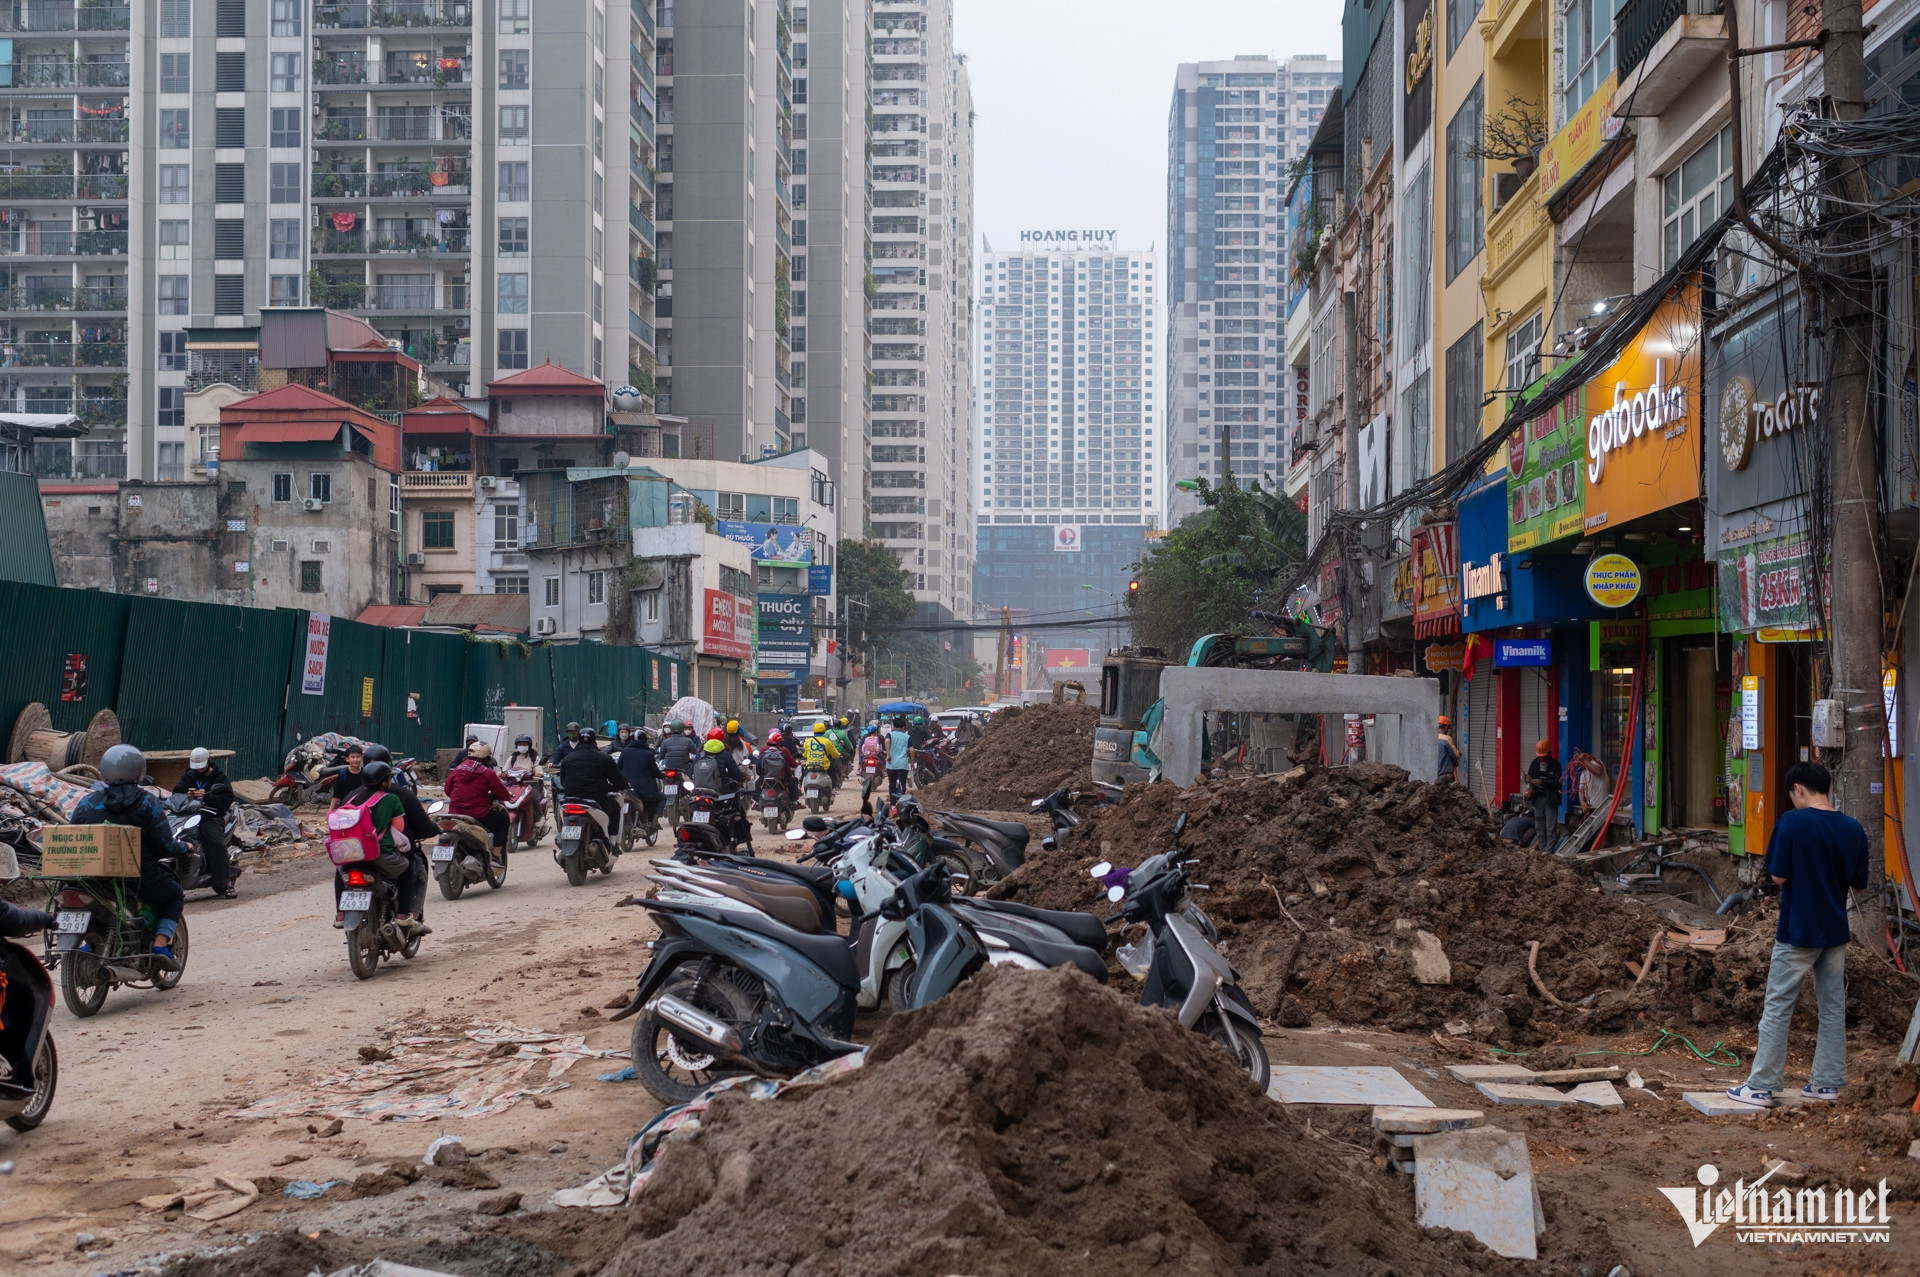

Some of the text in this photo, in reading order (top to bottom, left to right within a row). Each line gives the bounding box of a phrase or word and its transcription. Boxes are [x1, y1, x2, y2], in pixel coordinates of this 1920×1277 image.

[1020, 230, 1117, 241] HOANG HUY
[1296, 368, 1309, 425] KORE
[1588, 357, 1688, 484] gofood.vn
[735, 533, 755, 542] THUỐC
[1463, 552, 1504, 600] Vinamilk
[1592, 572, 1612, 580] THỰC
[1593, 581, 1613, 592] NHẬP
[712, 596, 732, 618] ENEOS
[759, 598, 802, 614] THUỐC
[322, 622, 329, 636] XE
[1502, 645, 1546, 656] Vinamilk
[810, 740, 826, 752] be
[52, 834, 94, 843] NGỌC LINH
[47, 845, 99, 855] TRƯỜNG SINH
[341, 901, 368, 910] 749.33
